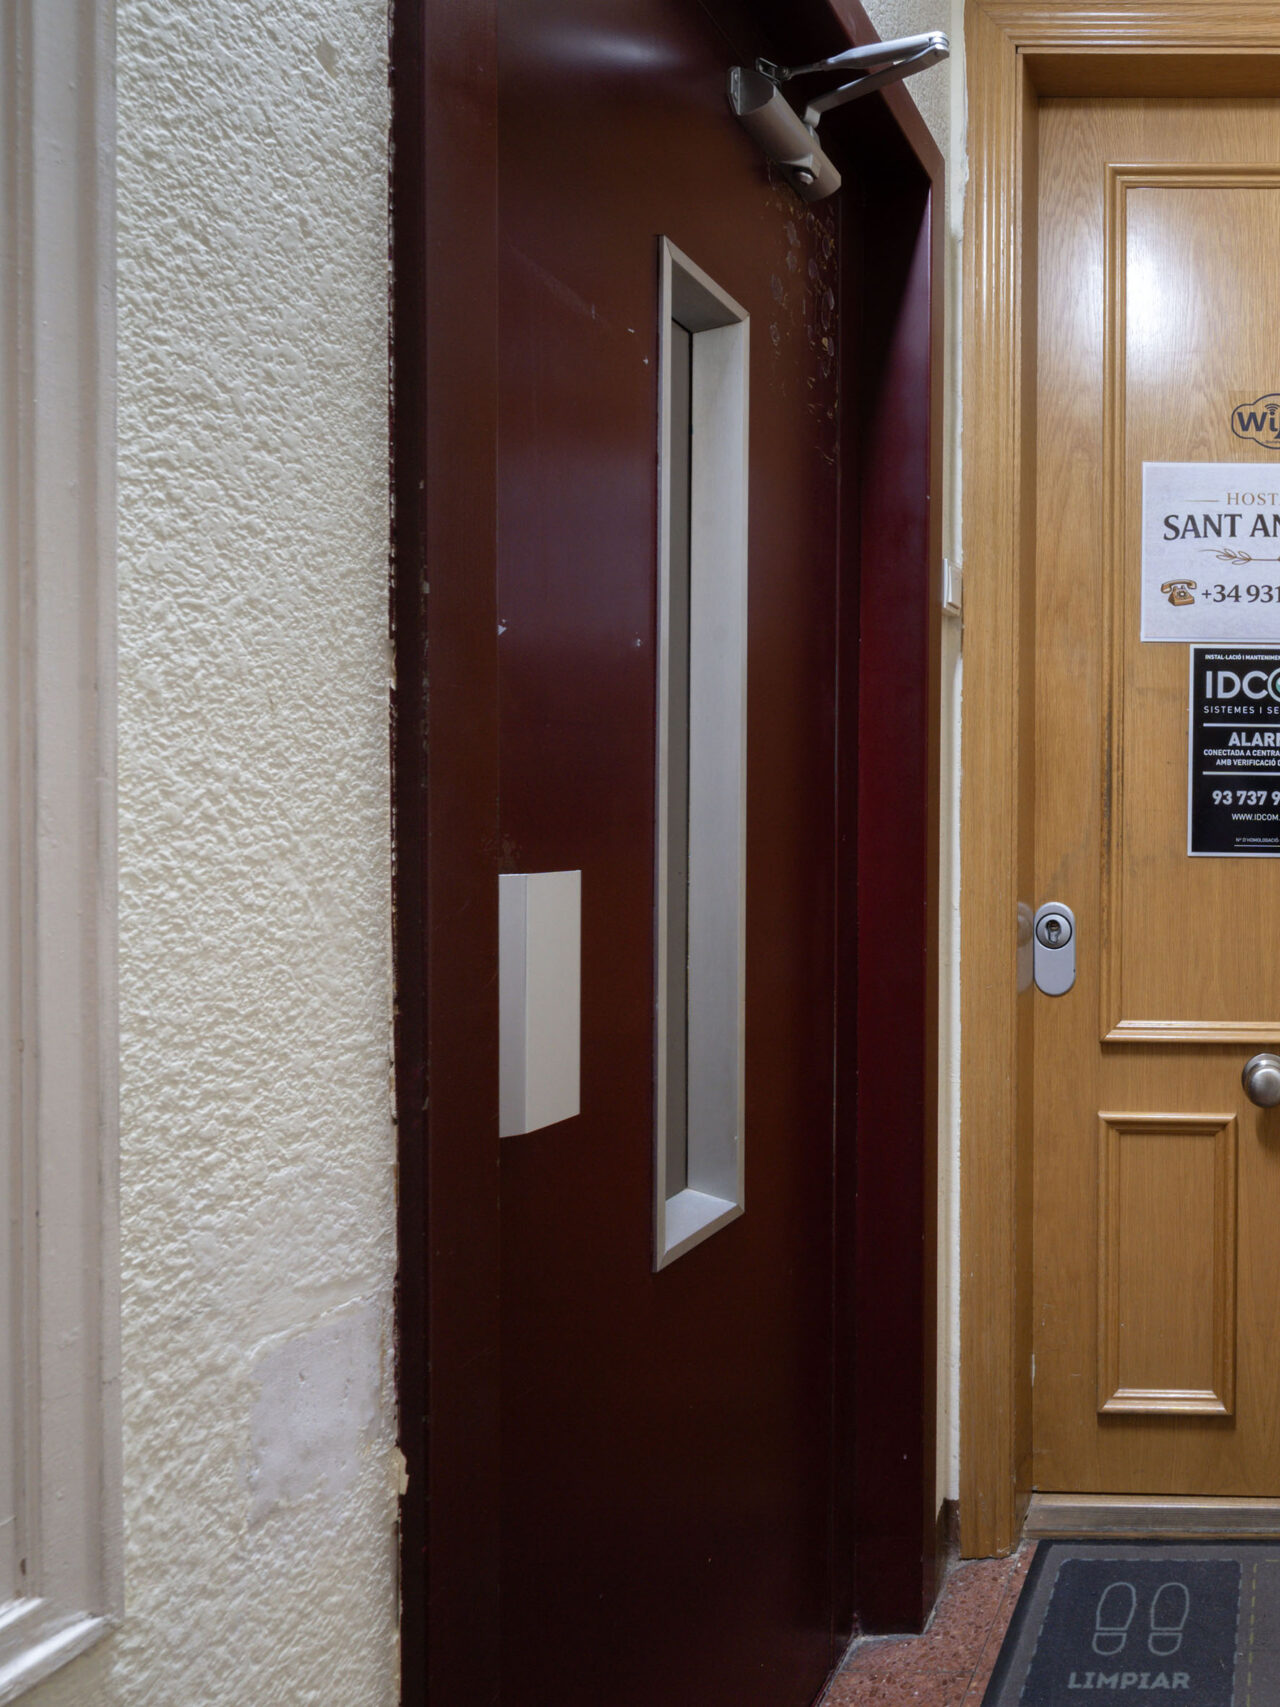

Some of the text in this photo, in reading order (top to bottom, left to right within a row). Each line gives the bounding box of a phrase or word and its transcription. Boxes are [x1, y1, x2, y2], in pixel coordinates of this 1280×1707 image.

[1163, 513, 1242, 541] SANT
[1203, 706, 1255, 714] SISTEMES
[1233, 758, 1275, 766] VERIFICACIÓ
[1212, 790, 1232, 805] 93
[1236, 791, 1267, 805] 737
[1068, 1671, 1190, 1690] LIMPIAR
